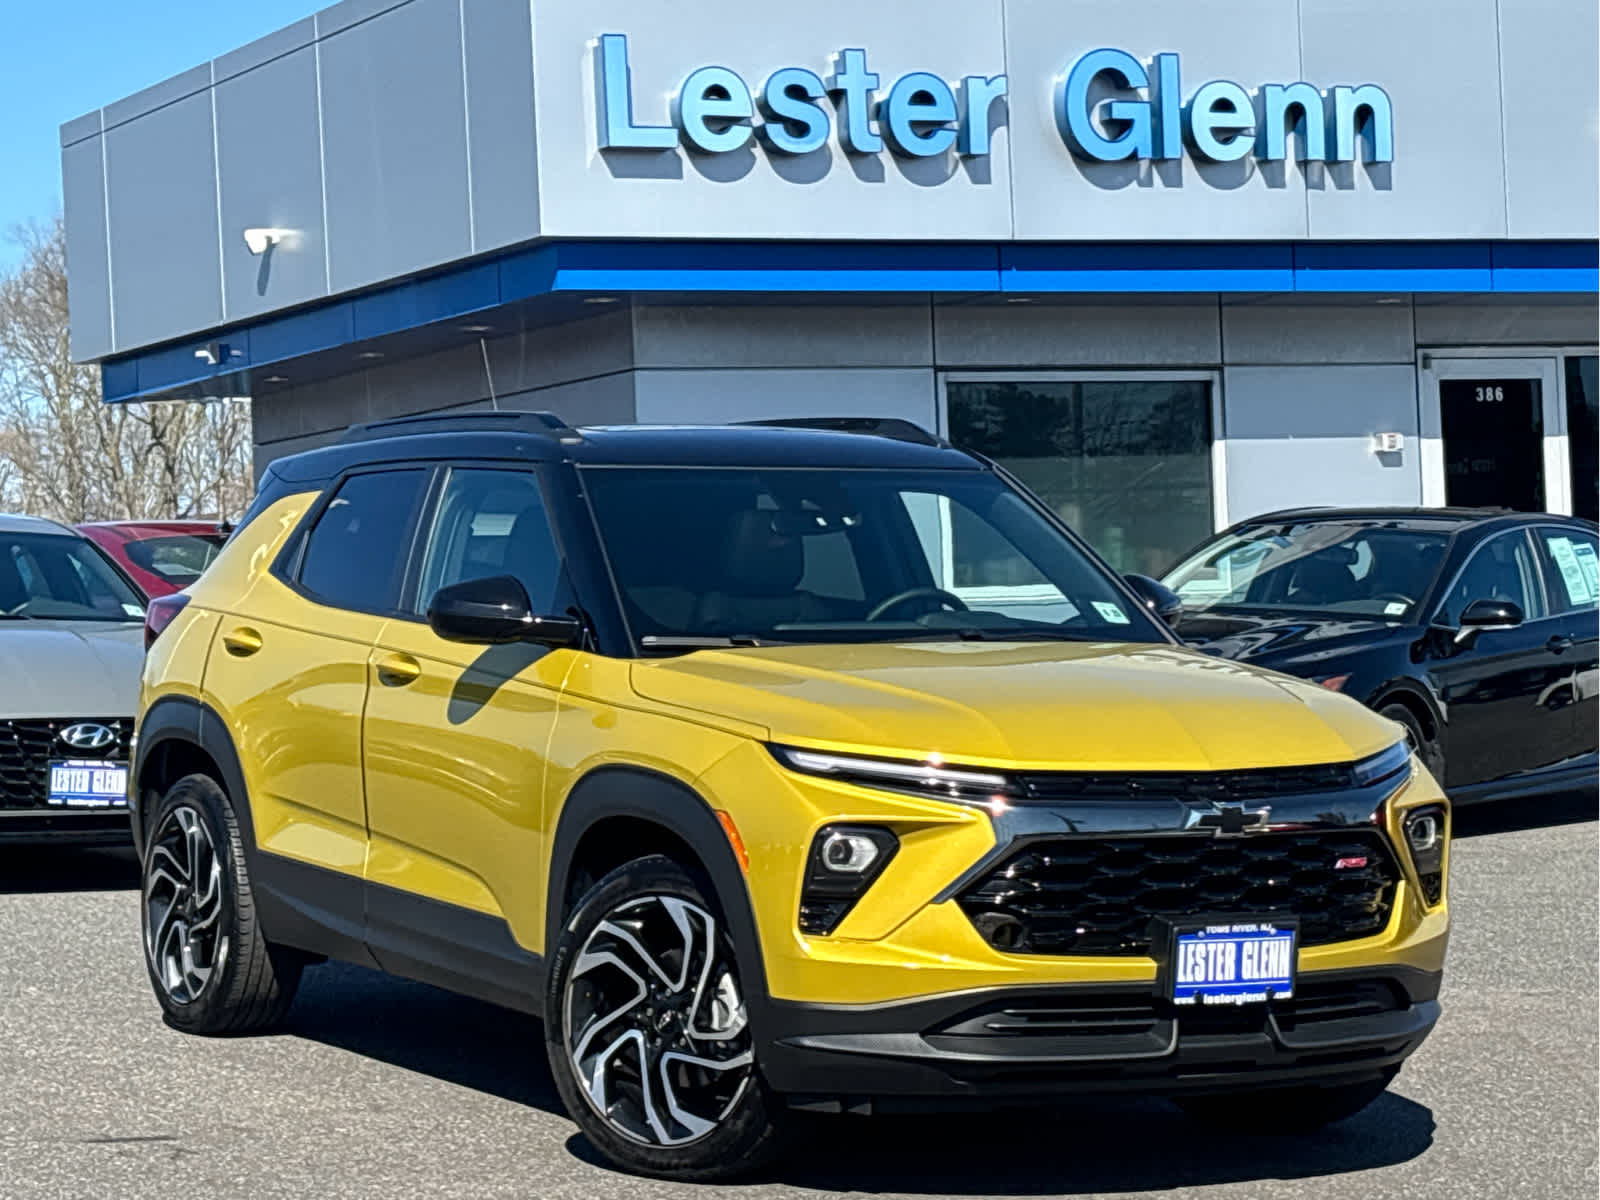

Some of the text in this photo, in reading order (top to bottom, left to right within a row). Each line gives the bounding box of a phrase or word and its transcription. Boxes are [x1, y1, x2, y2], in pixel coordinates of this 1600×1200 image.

[596, 33, 1393, 164] Lester Glenn
[1475, 387, 1504, 401] 386
[1177, 939, 1291, 983] LESTER GLENN
